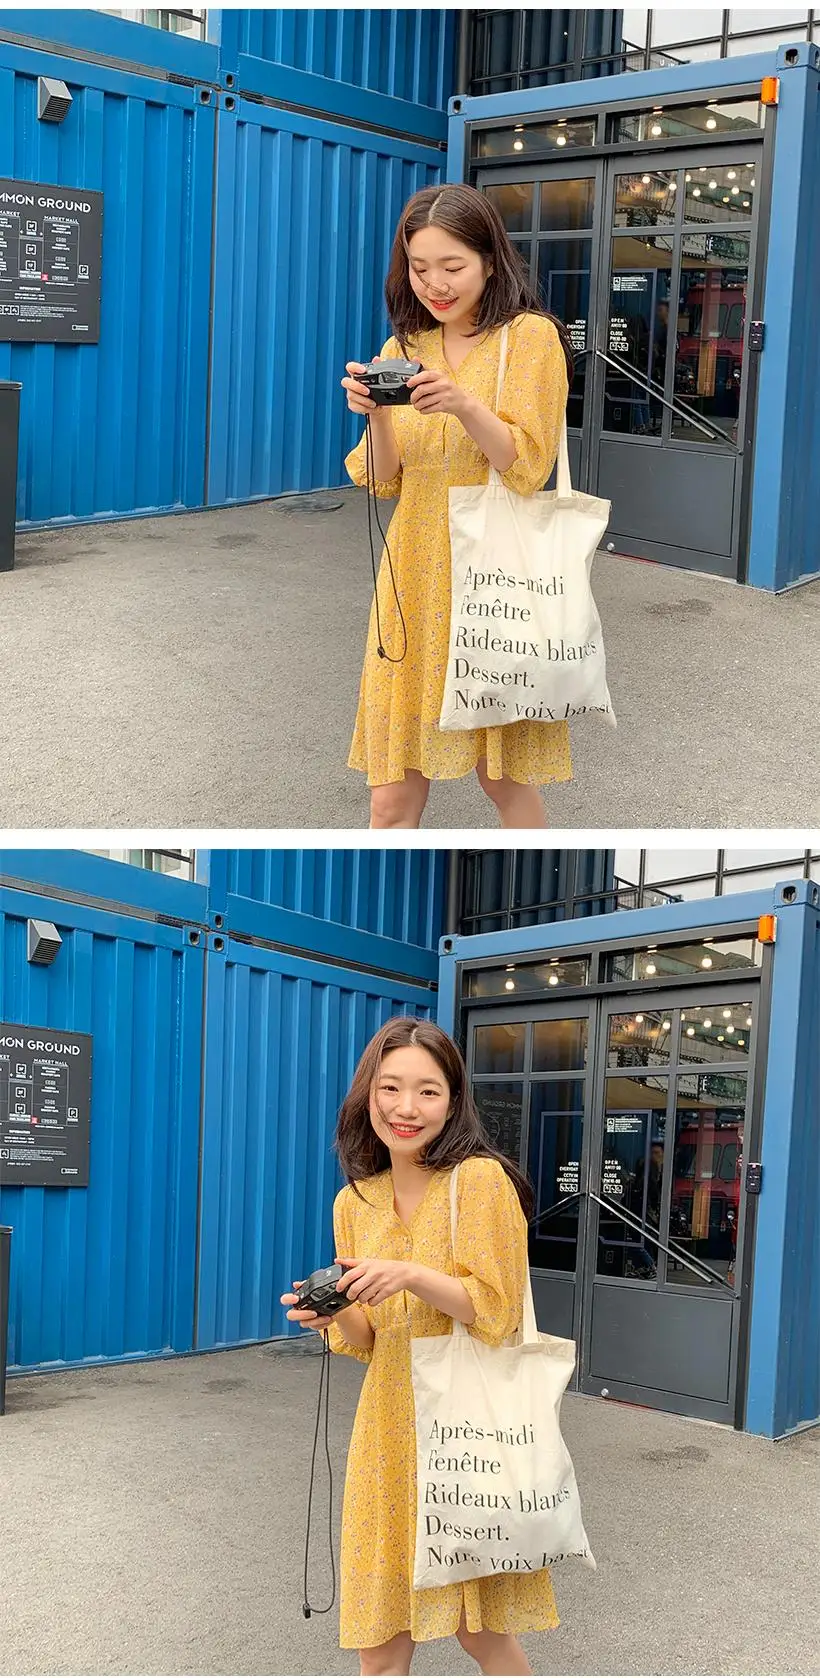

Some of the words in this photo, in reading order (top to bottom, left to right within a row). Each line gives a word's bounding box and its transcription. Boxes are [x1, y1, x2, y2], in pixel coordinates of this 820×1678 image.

[38, 197, 91, 213] GROUND
[464, 565, 564, 596] Après-midi
[455, 626, 539, 657] Rideaux
[454, 658, 535, 688] Dessert.
[455, 688, 506, 712] Notre
[515, 701, 556, 720] voix
[27, 1040, 80, 1055] GROUND
[429, 1419, 535, 1446] Après-midi
[425, 1482, 512, 1510] Rideaux
[424, 1514, 510, 1541] Dessert.
[427, 1545, 480, 1567] Notre
[490, 1553, 532, 1571] voix
